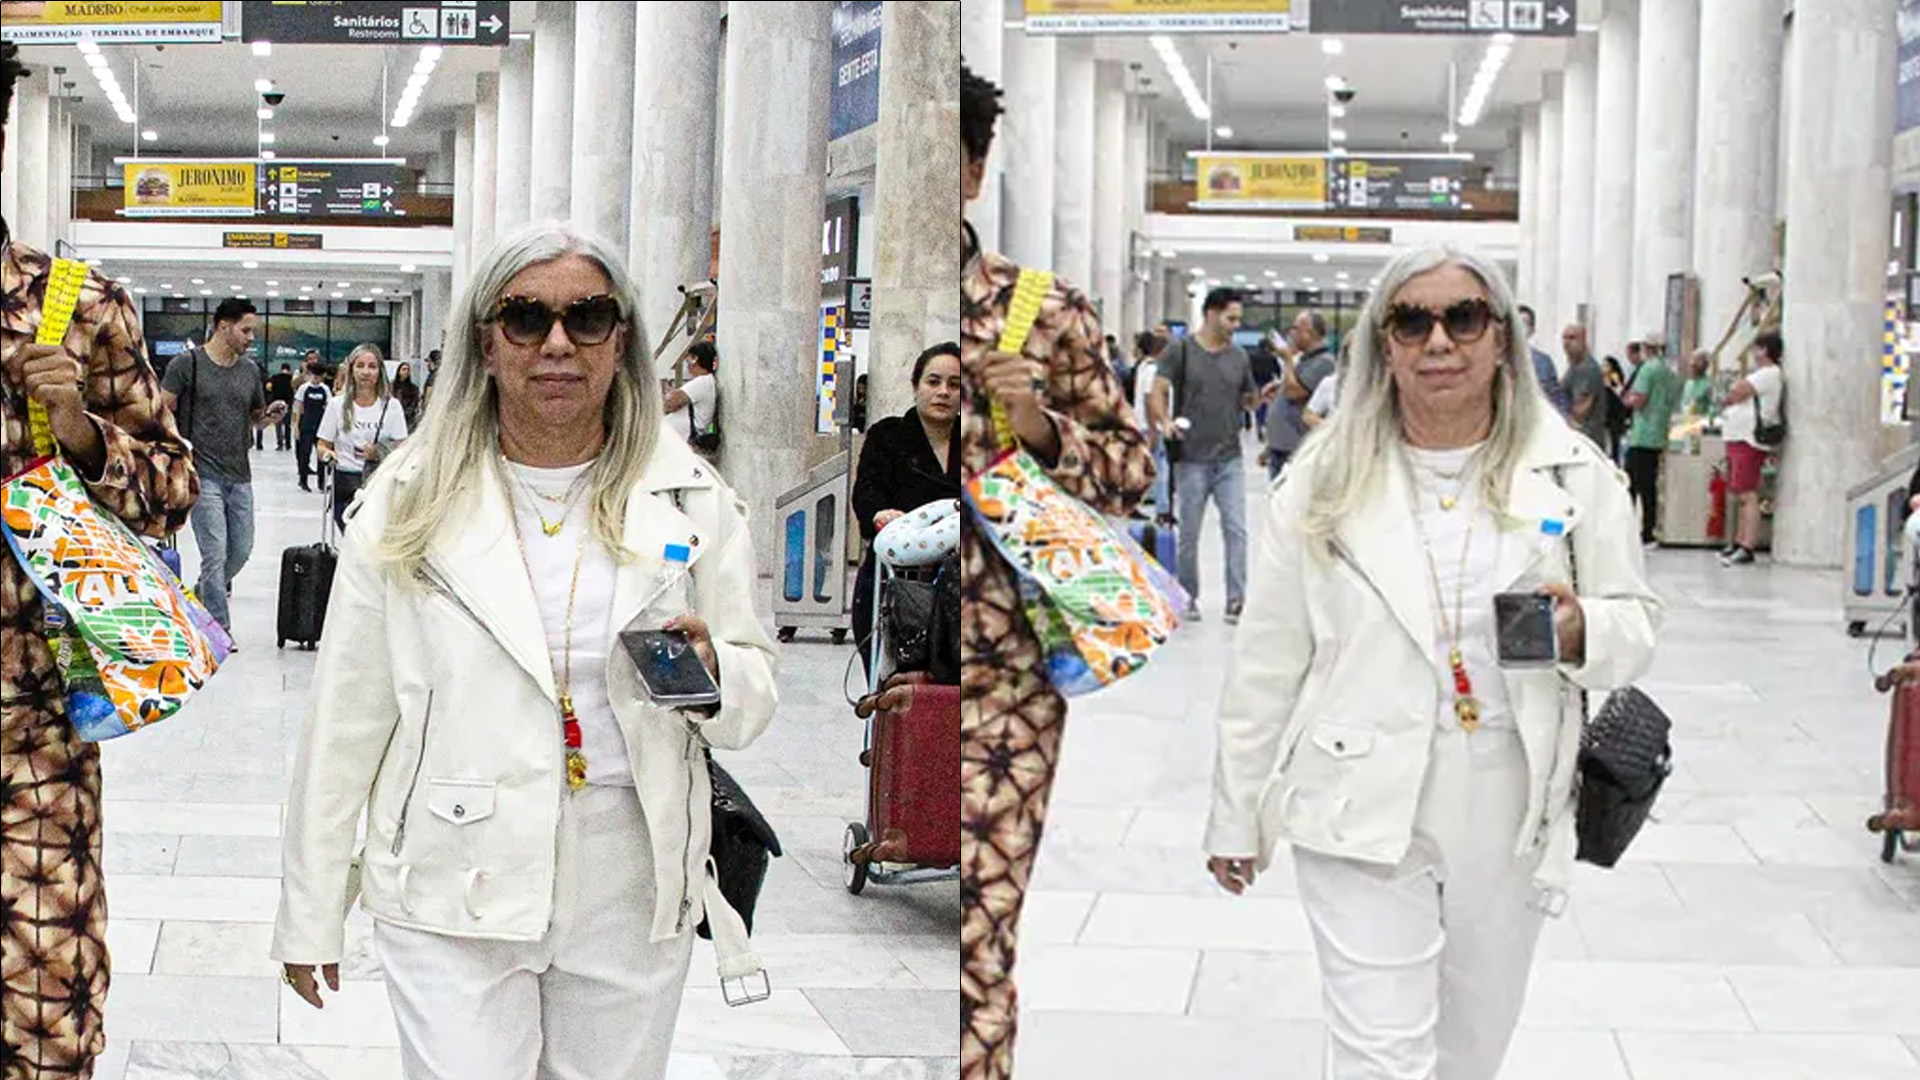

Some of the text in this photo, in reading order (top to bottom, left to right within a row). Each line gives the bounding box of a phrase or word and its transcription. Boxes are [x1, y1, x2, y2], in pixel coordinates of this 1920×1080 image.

[65, 4, 123, 16] MADERO
[333, 15, 400, 28] Sanitários
[13, 30, 83, 39] ALIMENTAÇÃO
[92, 29, 142, 37] TERMINAL
[160, 28, 215, 37] EMBARQUE
[348, 28, 400, 39] Restrooms
[177, 169, 247, 188] JERONIMO
